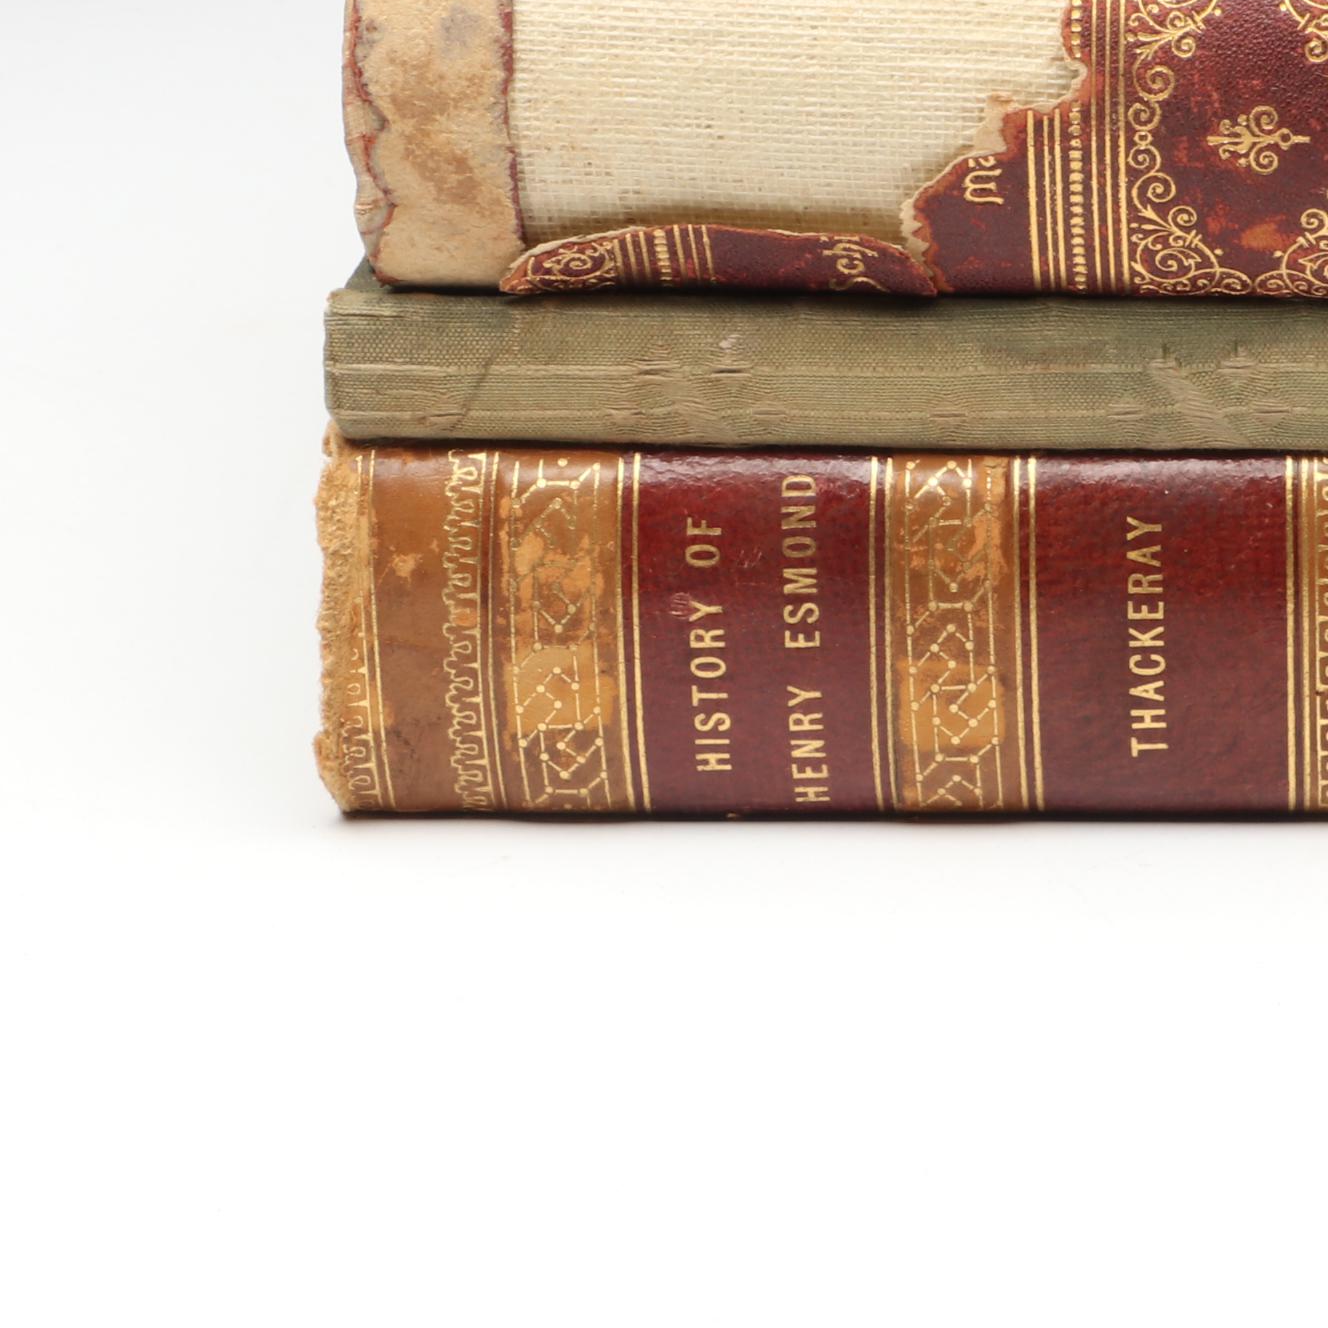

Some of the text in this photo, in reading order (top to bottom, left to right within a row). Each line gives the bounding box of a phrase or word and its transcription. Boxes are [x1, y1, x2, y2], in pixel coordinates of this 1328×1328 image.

[686, 516, 733, 771] HISTORY OF
[780, 473, 831, 803] HENRY ESMOND
[1125, 515, 1170, 756] THACKERAY
